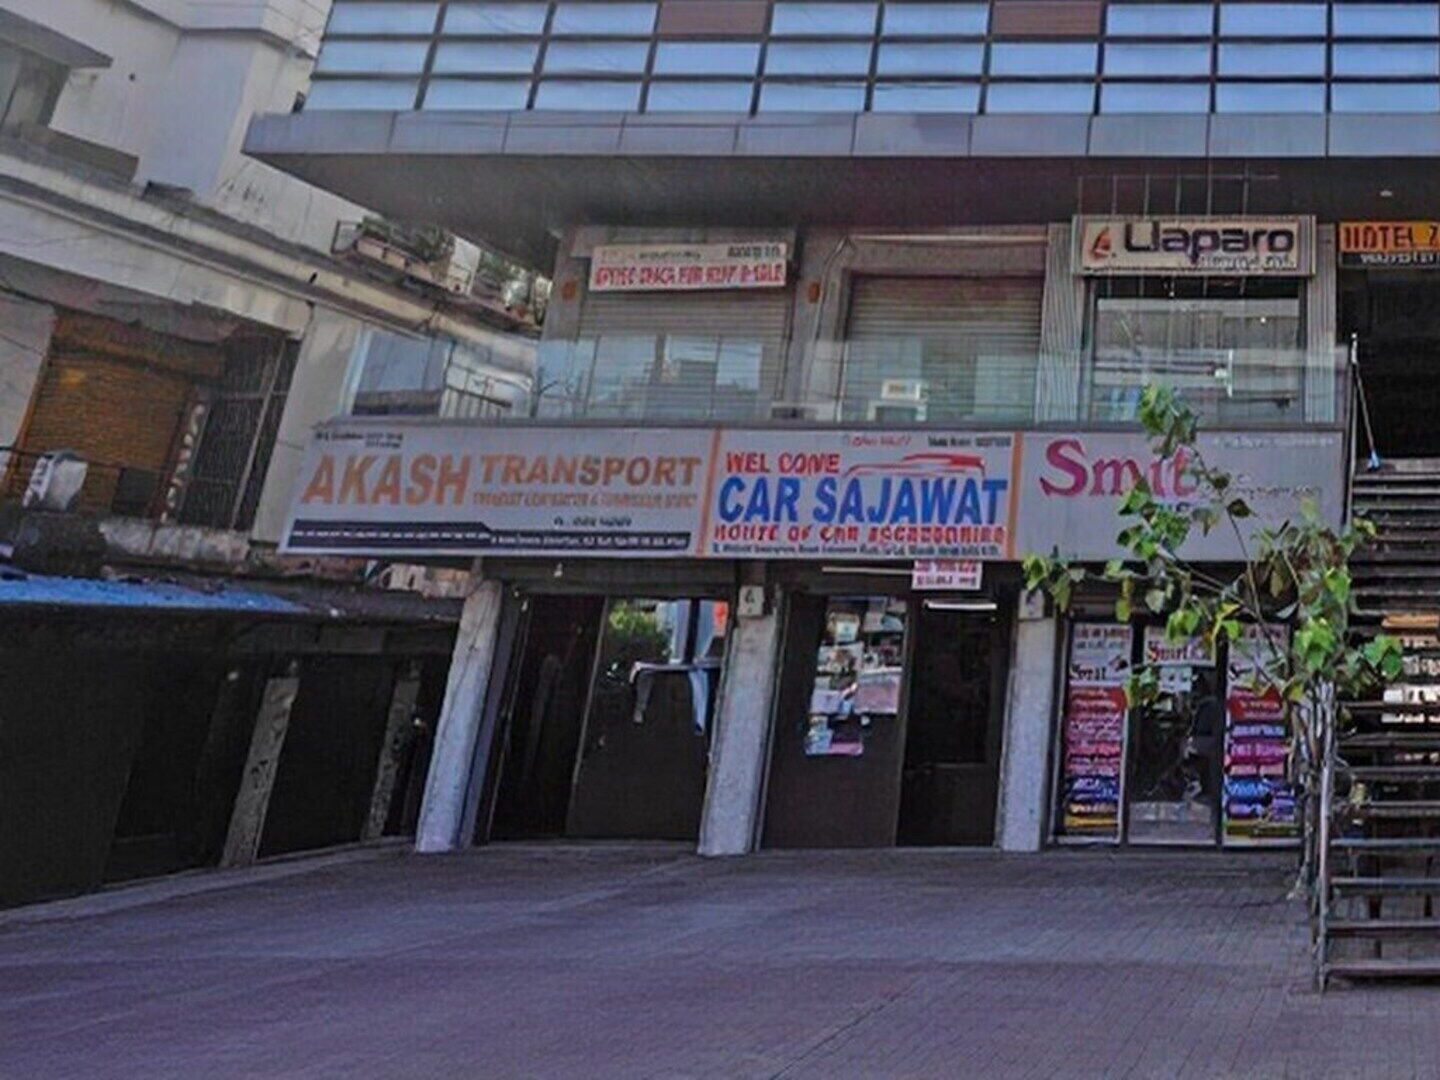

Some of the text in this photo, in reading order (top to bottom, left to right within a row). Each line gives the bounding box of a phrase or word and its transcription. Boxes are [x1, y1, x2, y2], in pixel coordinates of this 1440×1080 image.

[302, 453, 701, 506] AKASH TRANSPORT
[726, 452, 771, 474] WEL
[718, 476, 1009, 525] CAR SAJAWAT
